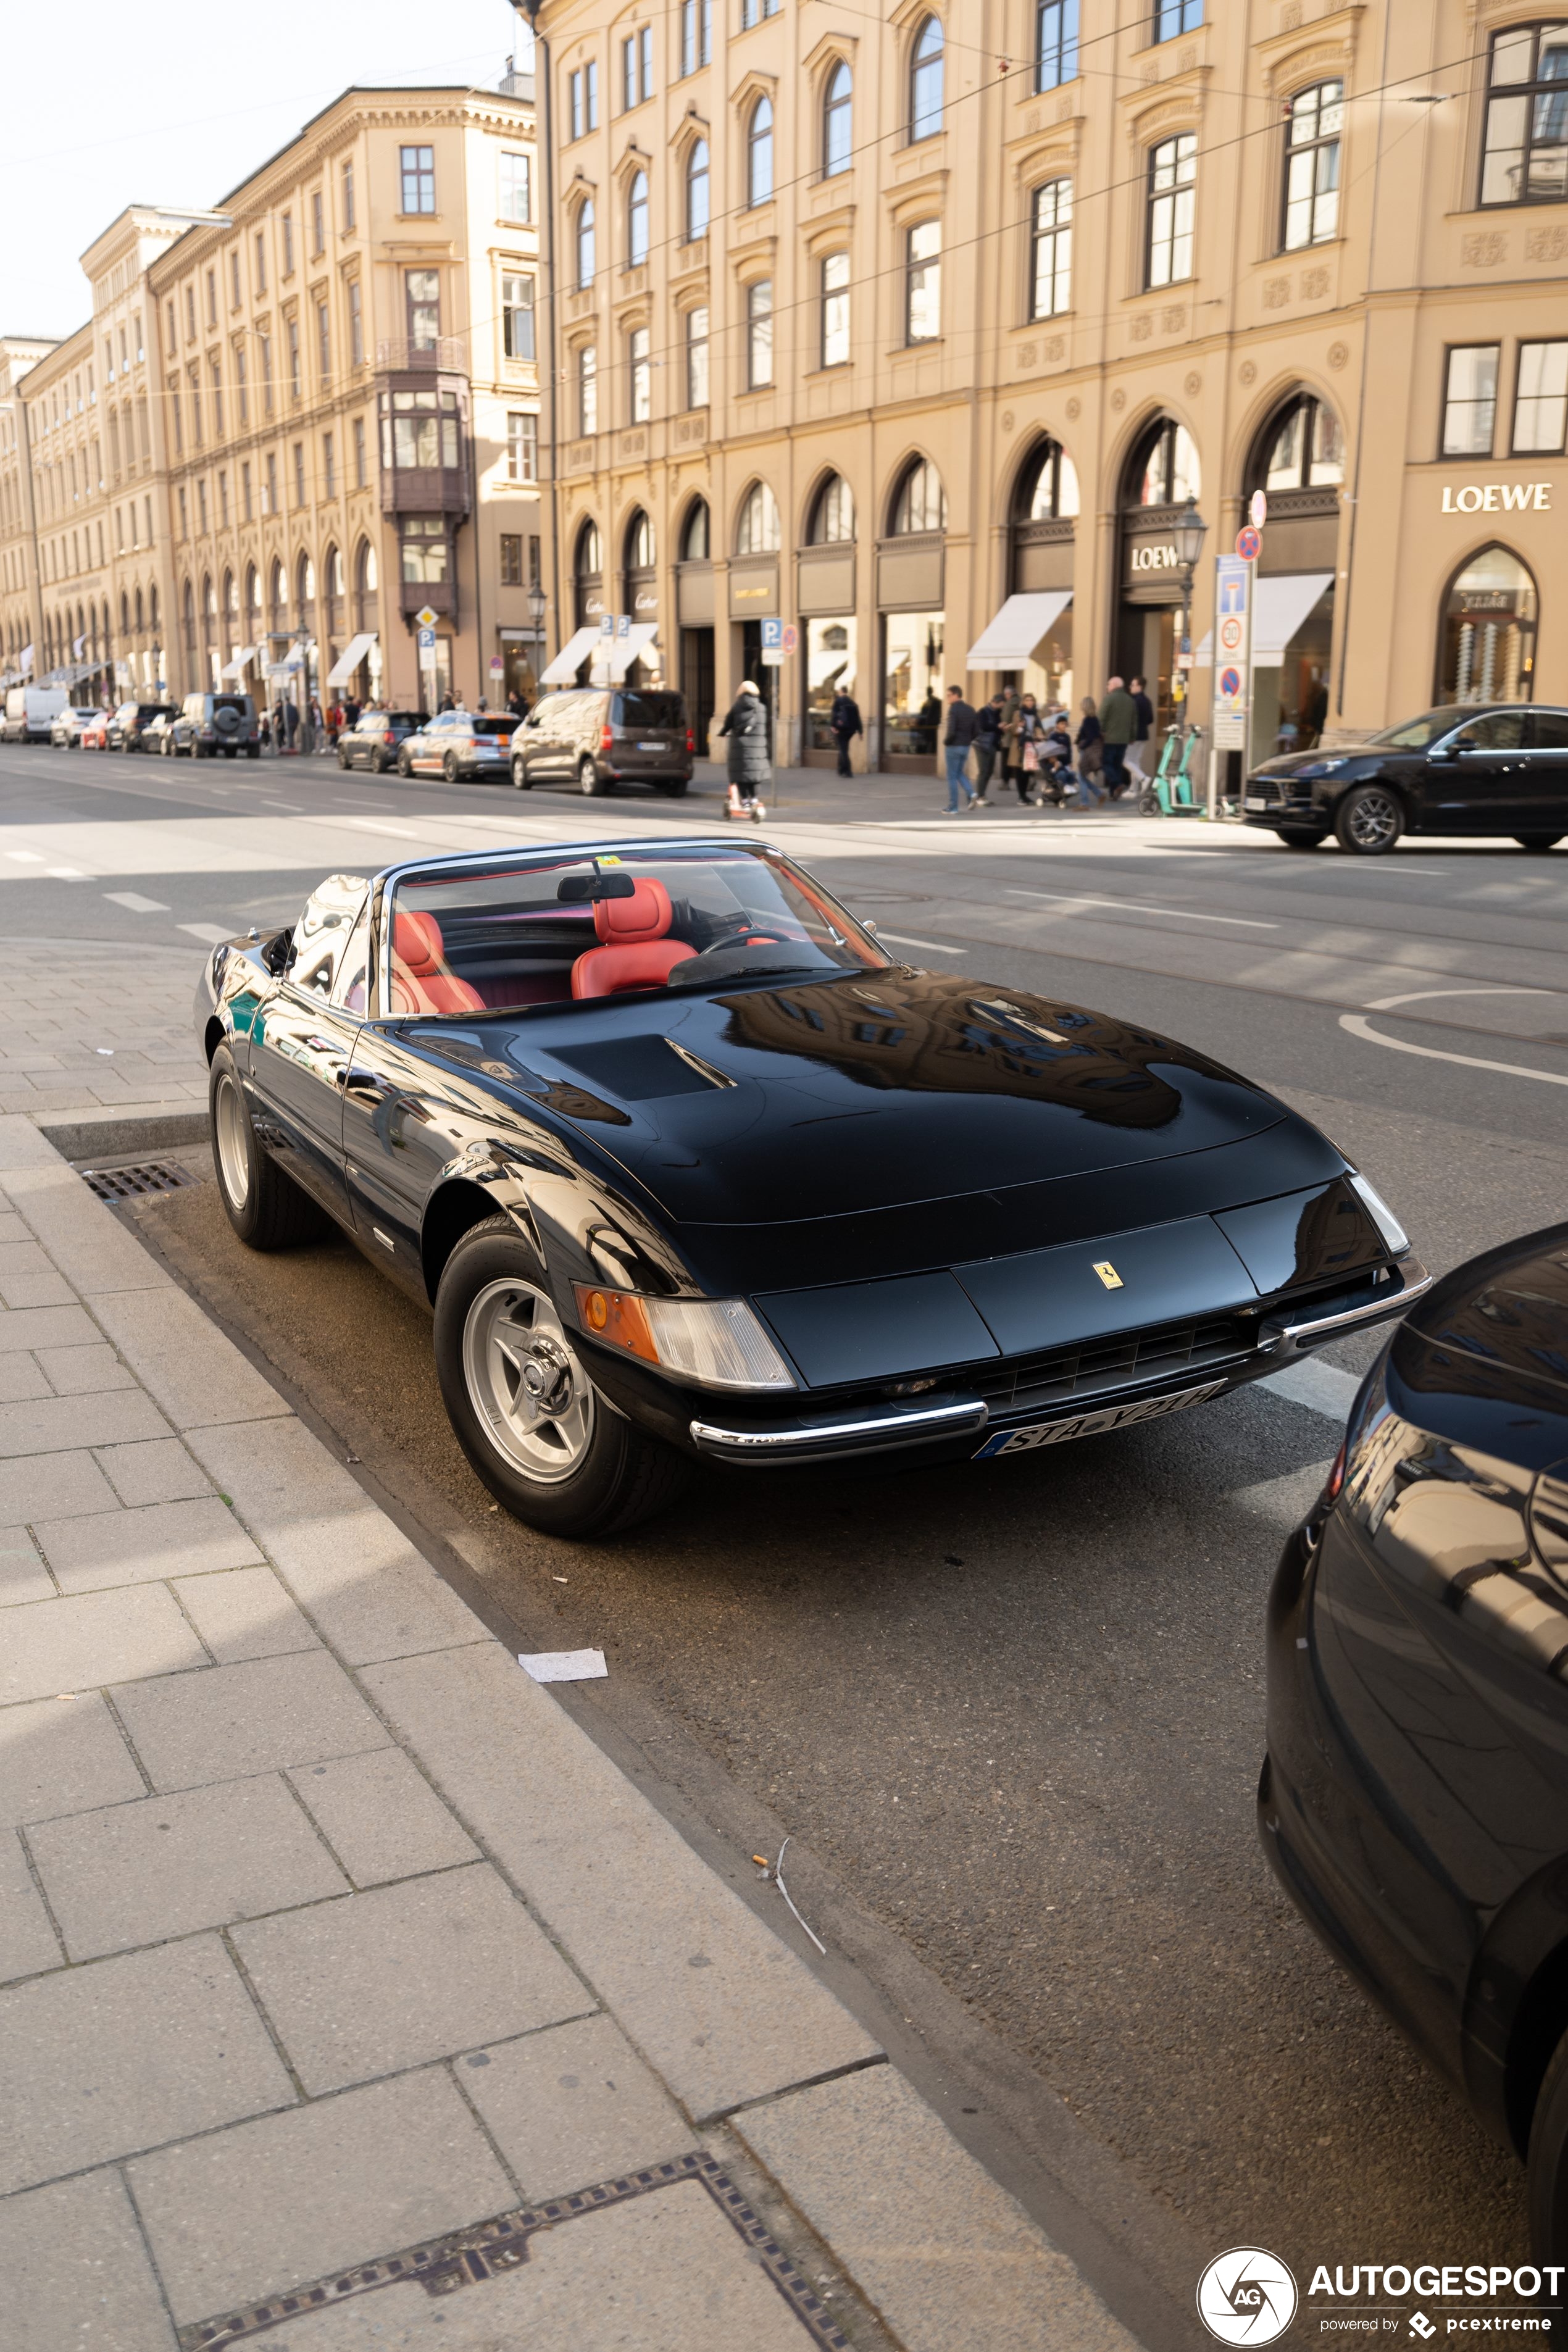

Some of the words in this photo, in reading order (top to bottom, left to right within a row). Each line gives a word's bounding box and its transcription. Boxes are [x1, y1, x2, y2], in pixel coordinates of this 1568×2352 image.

[1441, 483, 1553, 513] LOEWE
[1131, 545, 1190, 570] LOEW
[765, 622, 778, 644] P
[1225, 627, 1237, 641] 30
[1004, 1418, 1087, 1451] STA
